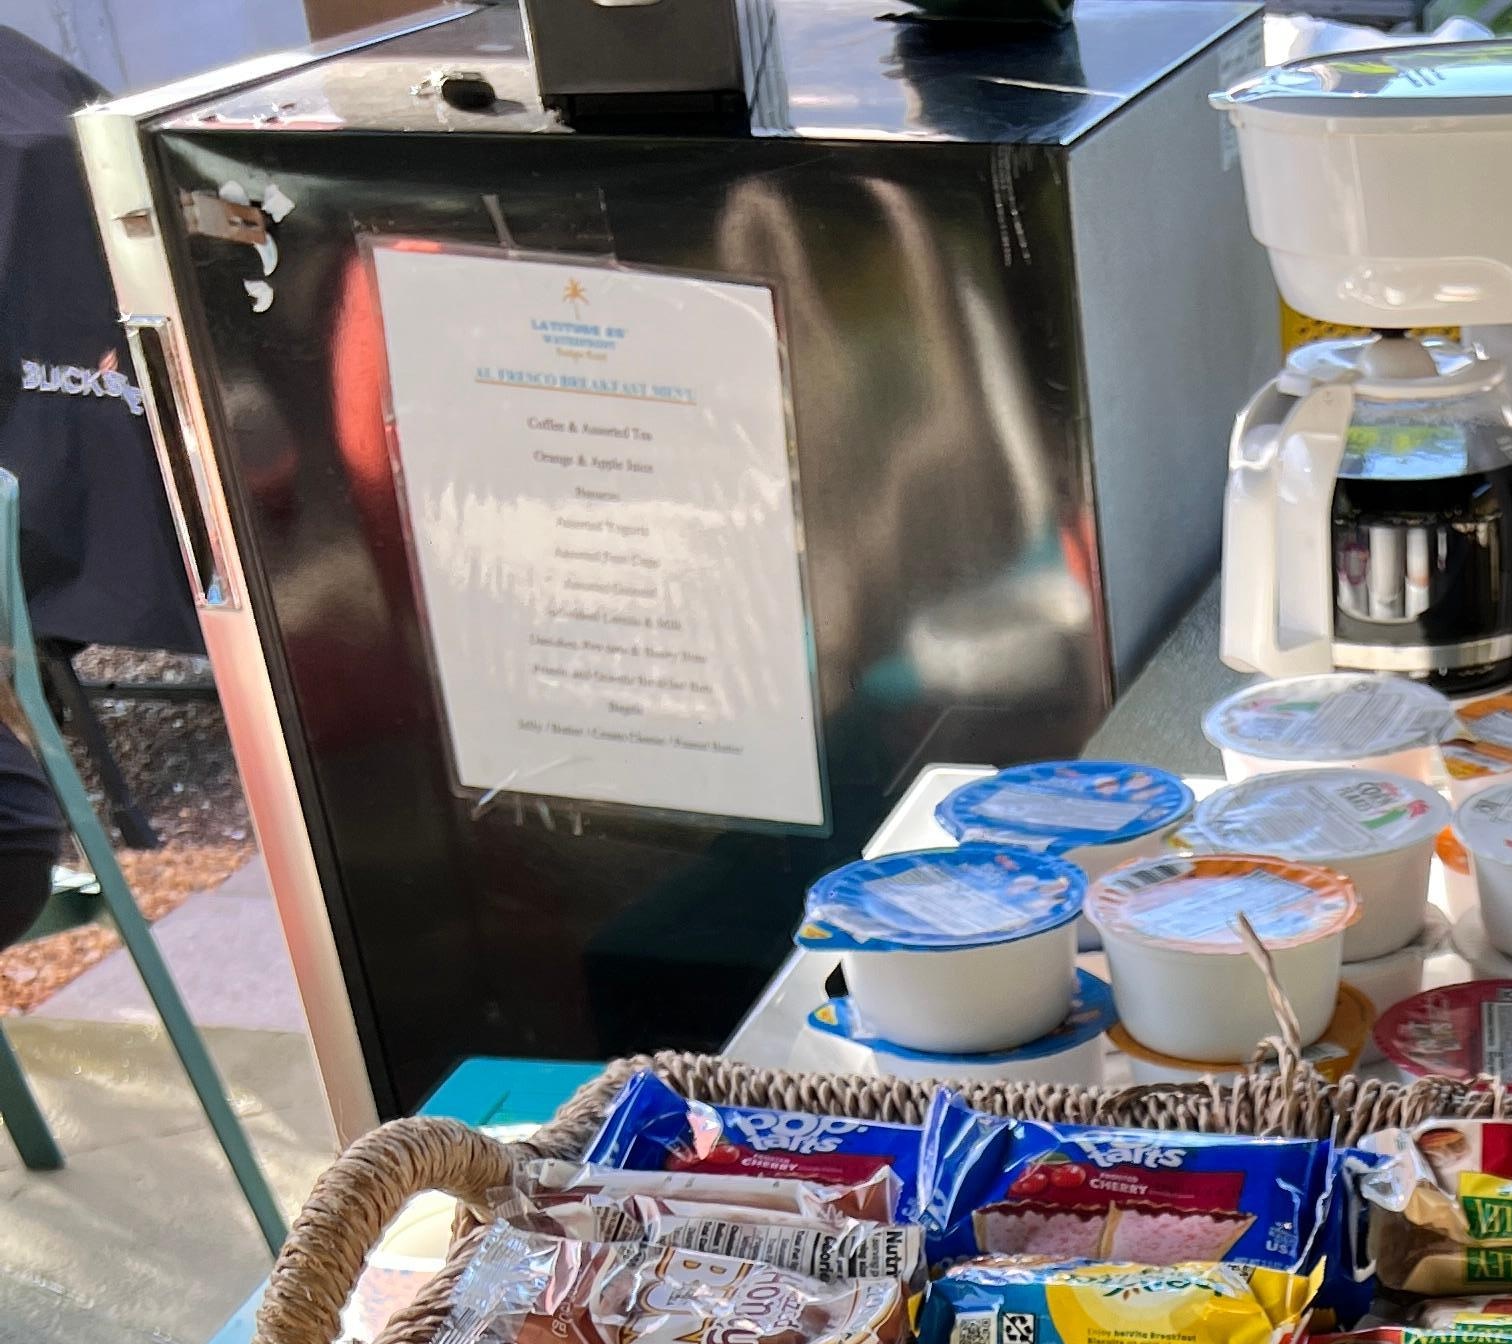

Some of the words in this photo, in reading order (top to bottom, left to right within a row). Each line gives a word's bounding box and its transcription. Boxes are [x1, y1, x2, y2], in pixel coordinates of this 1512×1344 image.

[559, 374, 647, 396] BREAKFAST
[527, 416, 566, 433] Coffee
[533, 451, 573, 467] Orange
[746, 1134, 844, 1155] tarts
[741, 1156, 800, 1172] CHERRY
[1087, 1145, 1188, 1169] tarts
[1089, 1178, 1149, 1196] CHERRY
[1150, 1331, 1198, 1342] Breakfast
